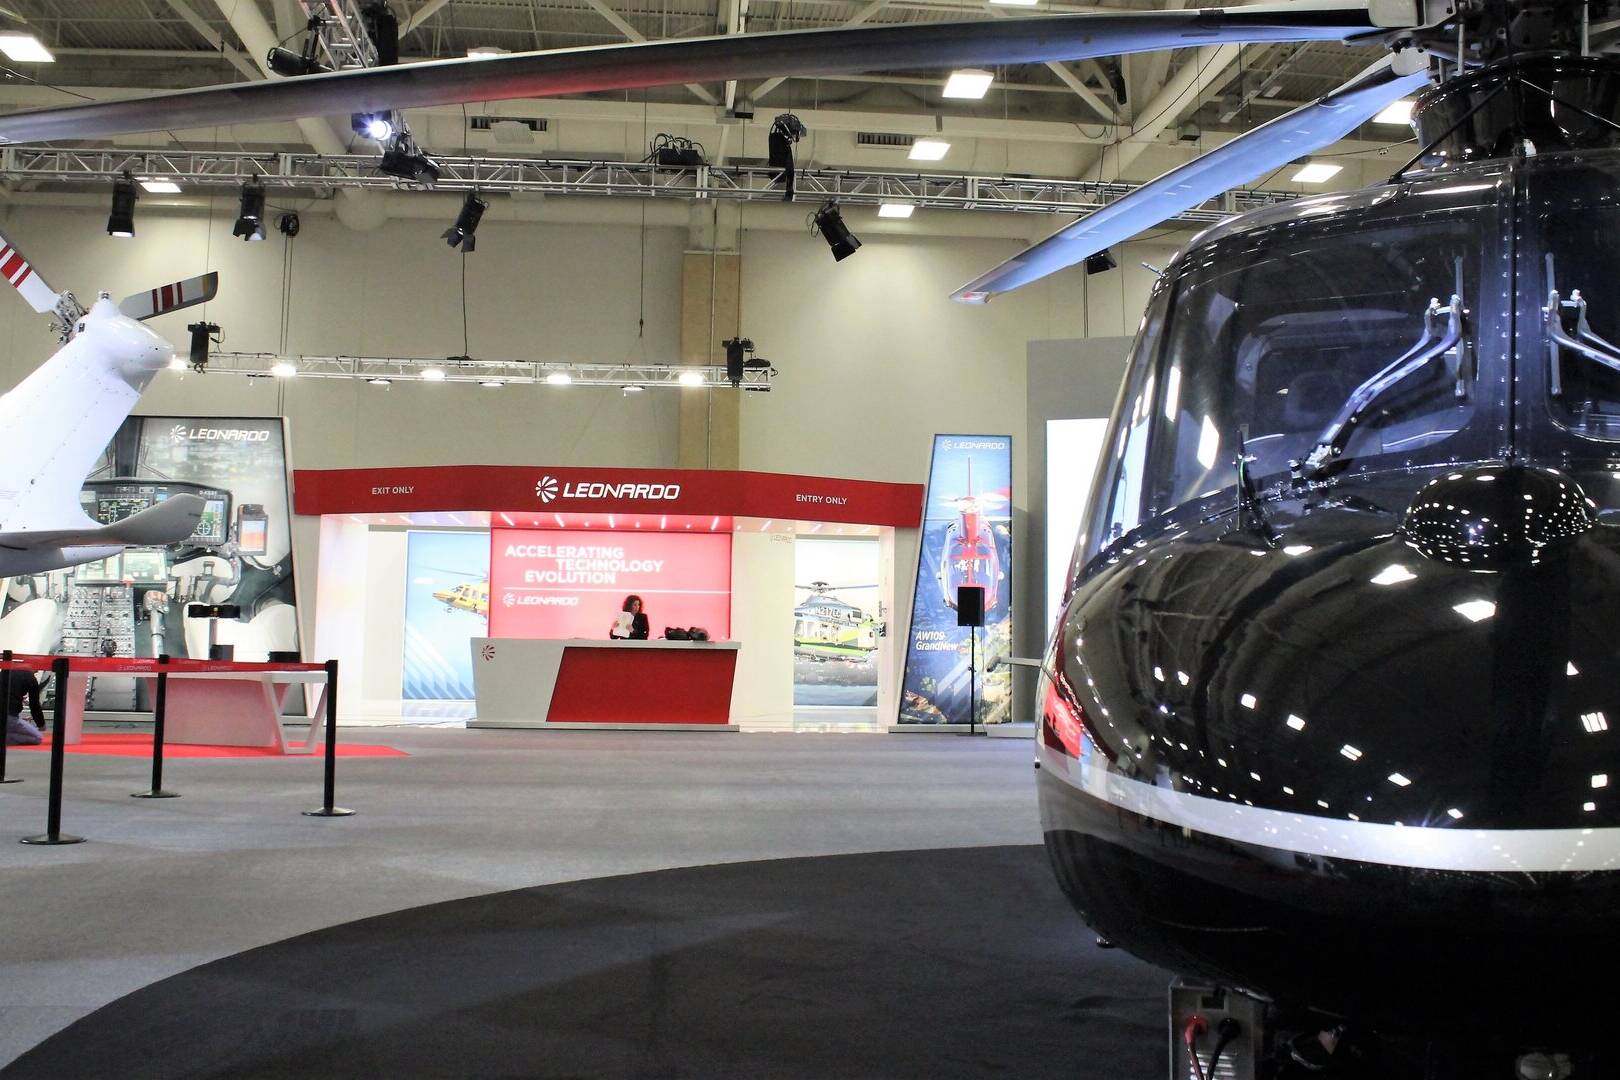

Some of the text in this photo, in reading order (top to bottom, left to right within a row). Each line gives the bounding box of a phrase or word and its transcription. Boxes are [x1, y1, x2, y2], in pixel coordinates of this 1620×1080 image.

[189, 428, 270, 441] LEONARDO
[953, 441, 1006, 450] LEONARDO
[371, 486, 415, 495] EXIT ONLY
[562, 482, 681, 500] LEONARDO
[795, 494, 847, 505] ENTRY ONLY
[504, 545, 624, 559] ACCELERATING
[555, 558, 664, 573] TECHNOLOGY
[524, 570, 616, 584] EVOLUTION
[516, 595, 580, 607] LEONARDO
[915, 630, 946, 641] AW109
